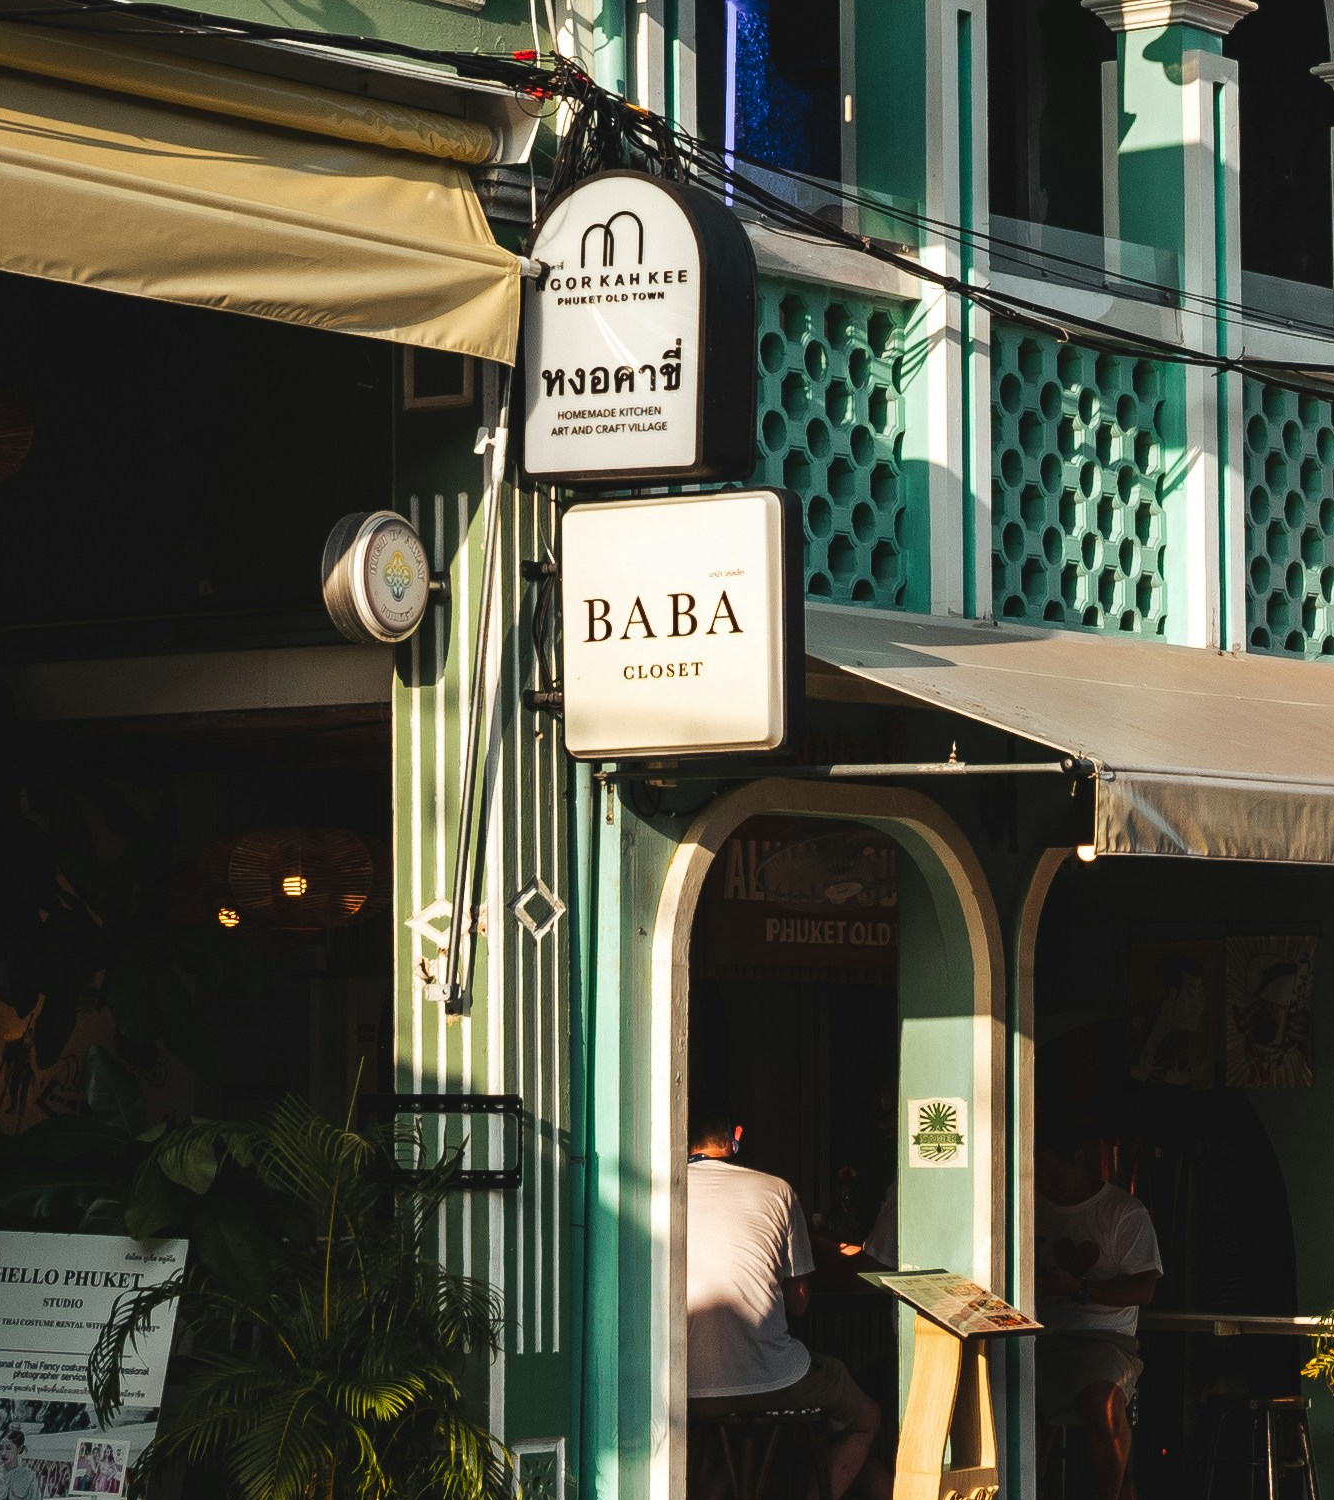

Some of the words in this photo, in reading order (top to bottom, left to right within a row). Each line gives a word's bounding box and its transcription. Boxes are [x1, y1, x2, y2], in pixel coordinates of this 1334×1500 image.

[600, 273, 640, 288] KAH
[648, 269, 688, 285] KEE
[557, 295, 602, 306] PHUKET
[605, 293, 629, 303] OLD
[632, 291, 665, 301] TOWN
[557, 406, 616, 421] HOMEMADE
[619, 404, 662, 418] KITCHEN
[551, 425, 569, 437] ART
[570, 424, 593, 437] AND
[595, 422, 627, 436] CRAFT
[628, 420, 668, 434] VILLAGE
[584, 590, 744, 644] BABA
[622, 660, 705, 681] CLOSET
[765, 918, 847, 944] PHUKET
[849, 922, 891, 946] OLD
[63, 1270, 145, 1290] PHUKET
[42, 1297, 84, 1309] STUDIO
[2, 1317, 19, 1326] THAI
[20, 1318, 55, 1328] COSTUME
[55, 1320, 86, 1329] RENTAL
[15, 1360, 23, 1369] of
[24, 1360, 39, 1370] Thai
